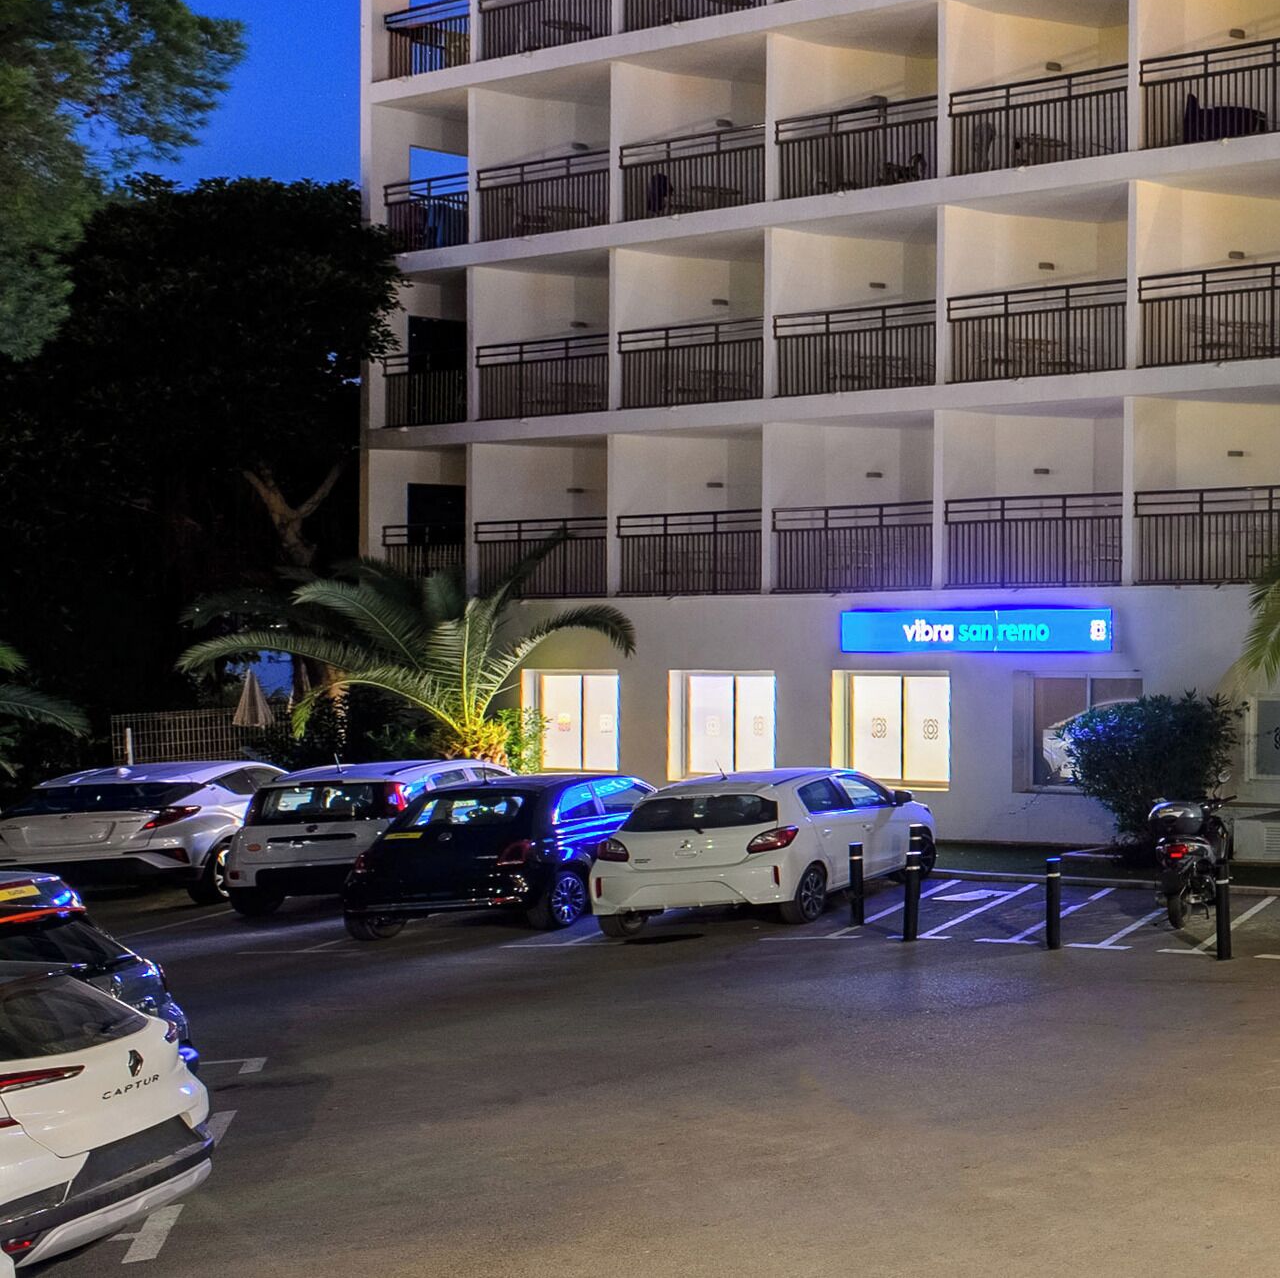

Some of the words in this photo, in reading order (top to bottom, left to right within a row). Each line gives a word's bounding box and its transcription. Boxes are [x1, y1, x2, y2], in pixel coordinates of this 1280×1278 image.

[902, 619, 954, 642] vibra
[958, 623, 993, 642] san
[997, 623, 1050, 642] remo
[102, 1074, 160, 1100] CAPTUR
